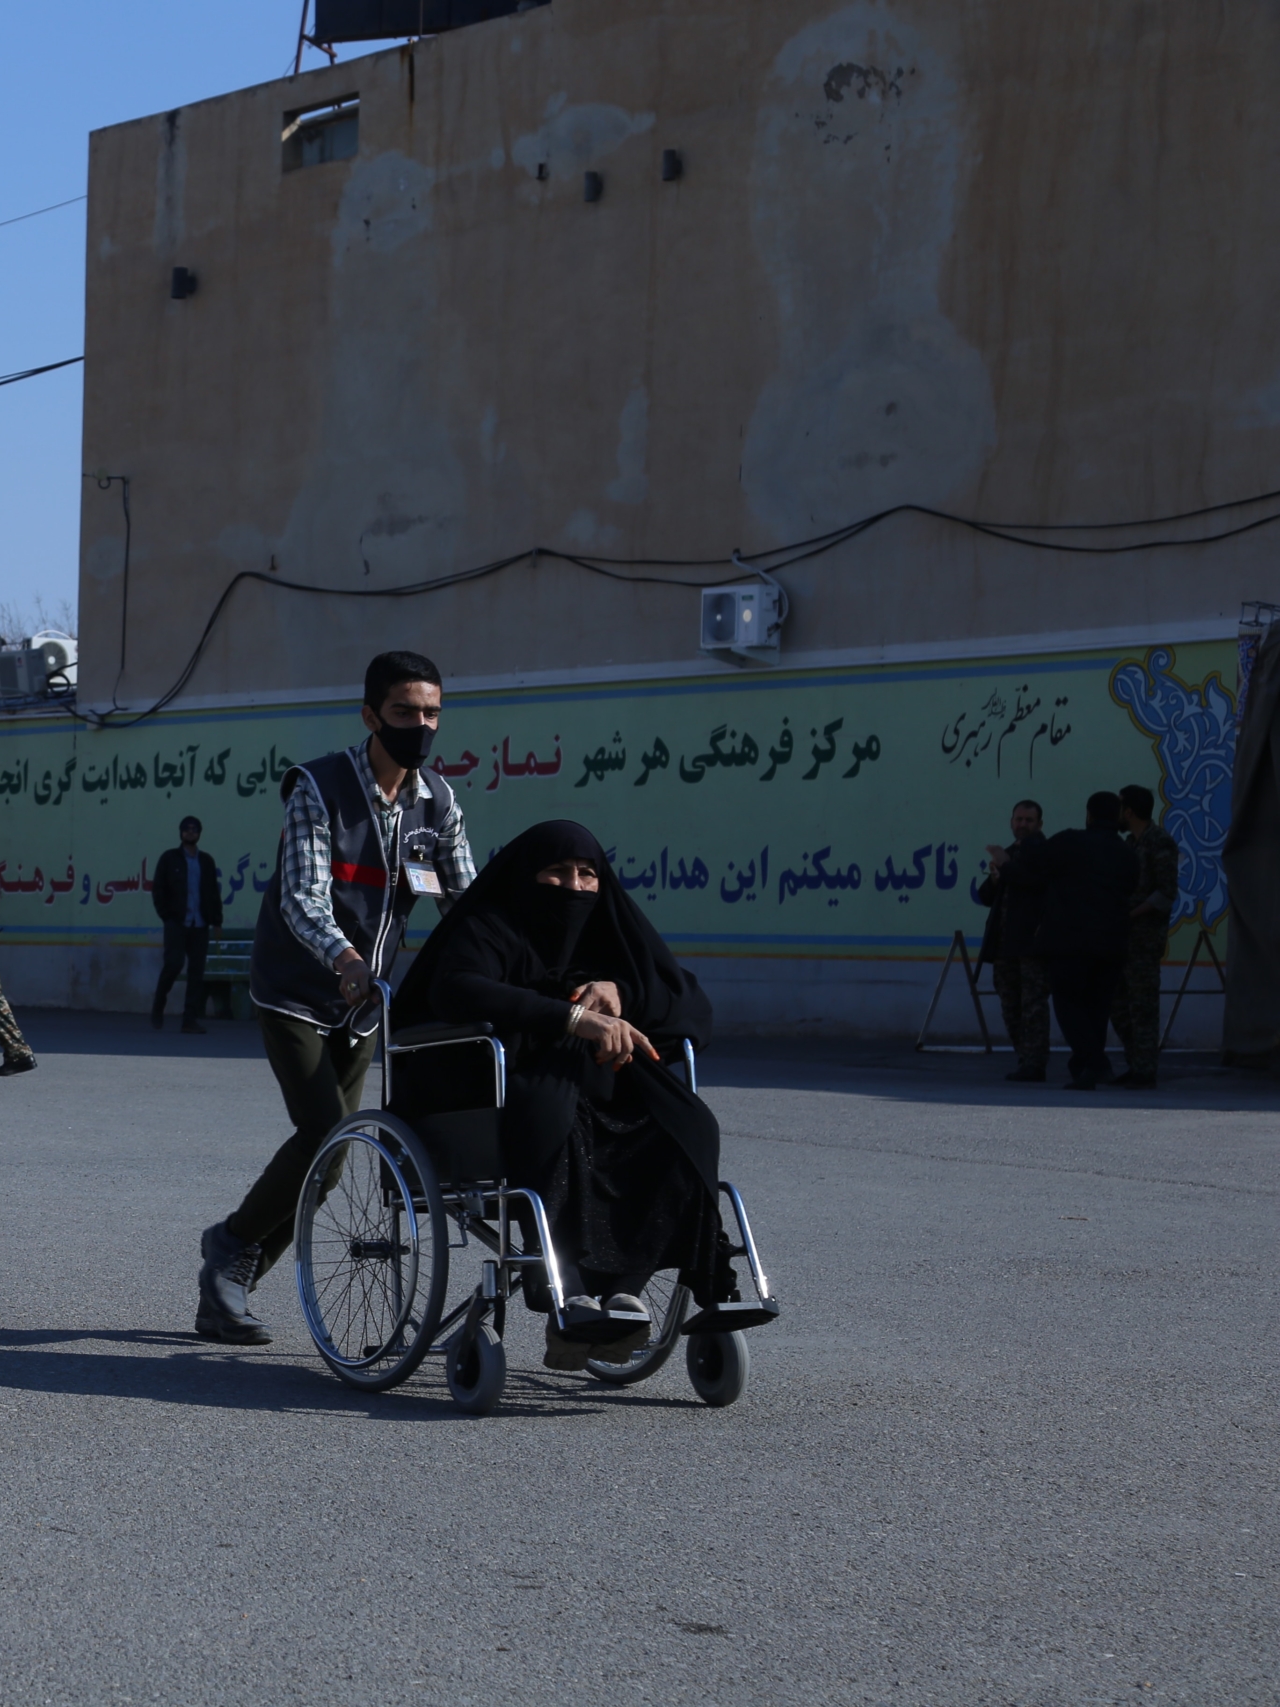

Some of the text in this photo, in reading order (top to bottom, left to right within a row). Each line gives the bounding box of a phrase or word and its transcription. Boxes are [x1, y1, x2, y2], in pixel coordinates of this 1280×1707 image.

[486, 734, 562, 790] نماز
[574, 730, 627, 787] شهر
[633, 736, 670, 787] هر
[679, 717, 794, 784] فرهنگی
[803, 718, 882, 781] مرکز
[941, 712, 993, 767] رهبری
[1030, 696, 1072, 780] مقام
[34, 757, 77, 805] گری
[82, 753, 148, 805] هدایت
[154, 744, 201, 798] آنجا
[204, 747, 231, 786] که
[429, 750, 480, 788] جم
[79, 873, 91, 905] و
[720, 846, 769, 903] این
[778, 846, 861, 904] میکنم
[873, 841, 959, 903] تاکید
